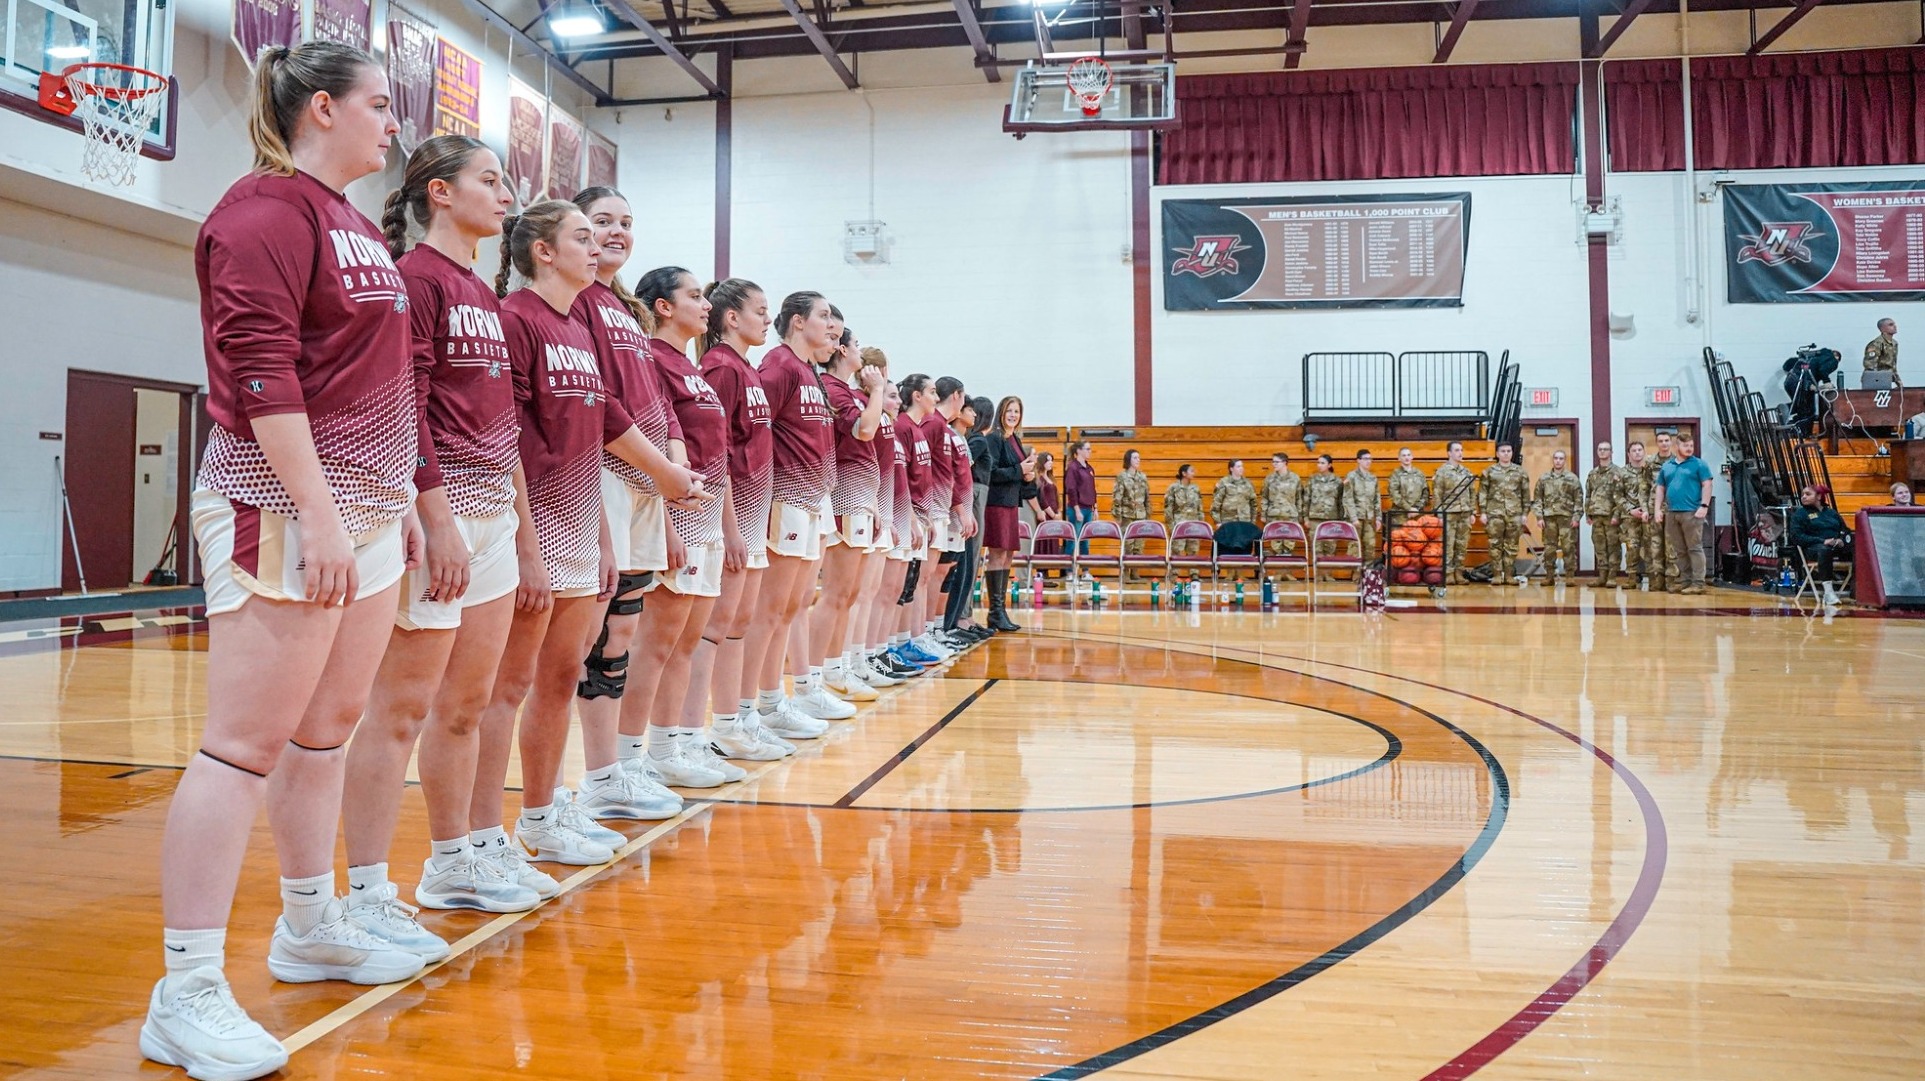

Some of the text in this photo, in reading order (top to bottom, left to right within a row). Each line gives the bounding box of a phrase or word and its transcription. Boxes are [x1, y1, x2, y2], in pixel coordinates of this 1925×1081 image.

[1833, 197, 1925, 206] WOMEN'S BASKET
[1268, 207, 1449, 219] MEN'S BASKETBALL 1,000 POINT CLUB
[1533, 390, 1551, 404] EXIT
[1655, 389, 1673, 402] EXIT
